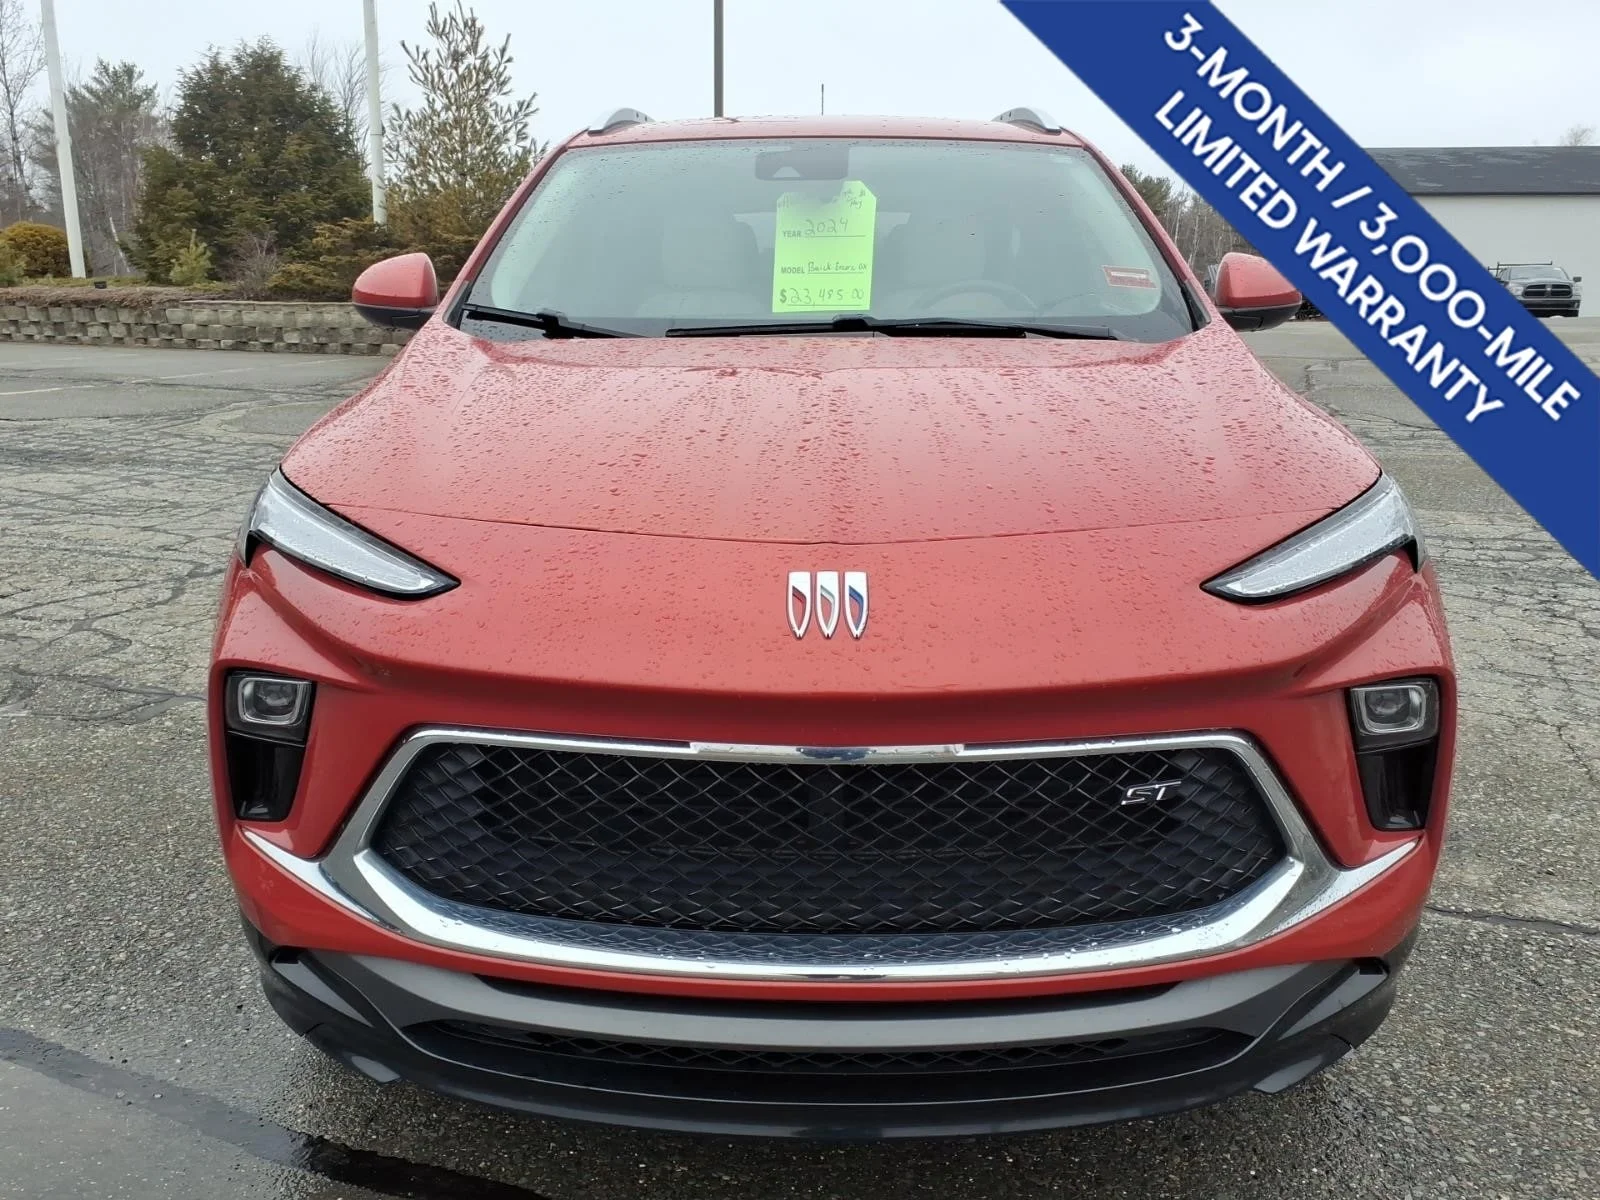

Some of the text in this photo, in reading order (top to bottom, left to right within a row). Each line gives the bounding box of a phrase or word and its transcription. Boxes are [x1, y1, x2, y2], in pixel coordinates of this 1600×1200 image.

[782, 218, 849, 238] YEAR 2024
[781, 266, 806, 274] MODEL
[1121, 780, 1182, 805] ST
